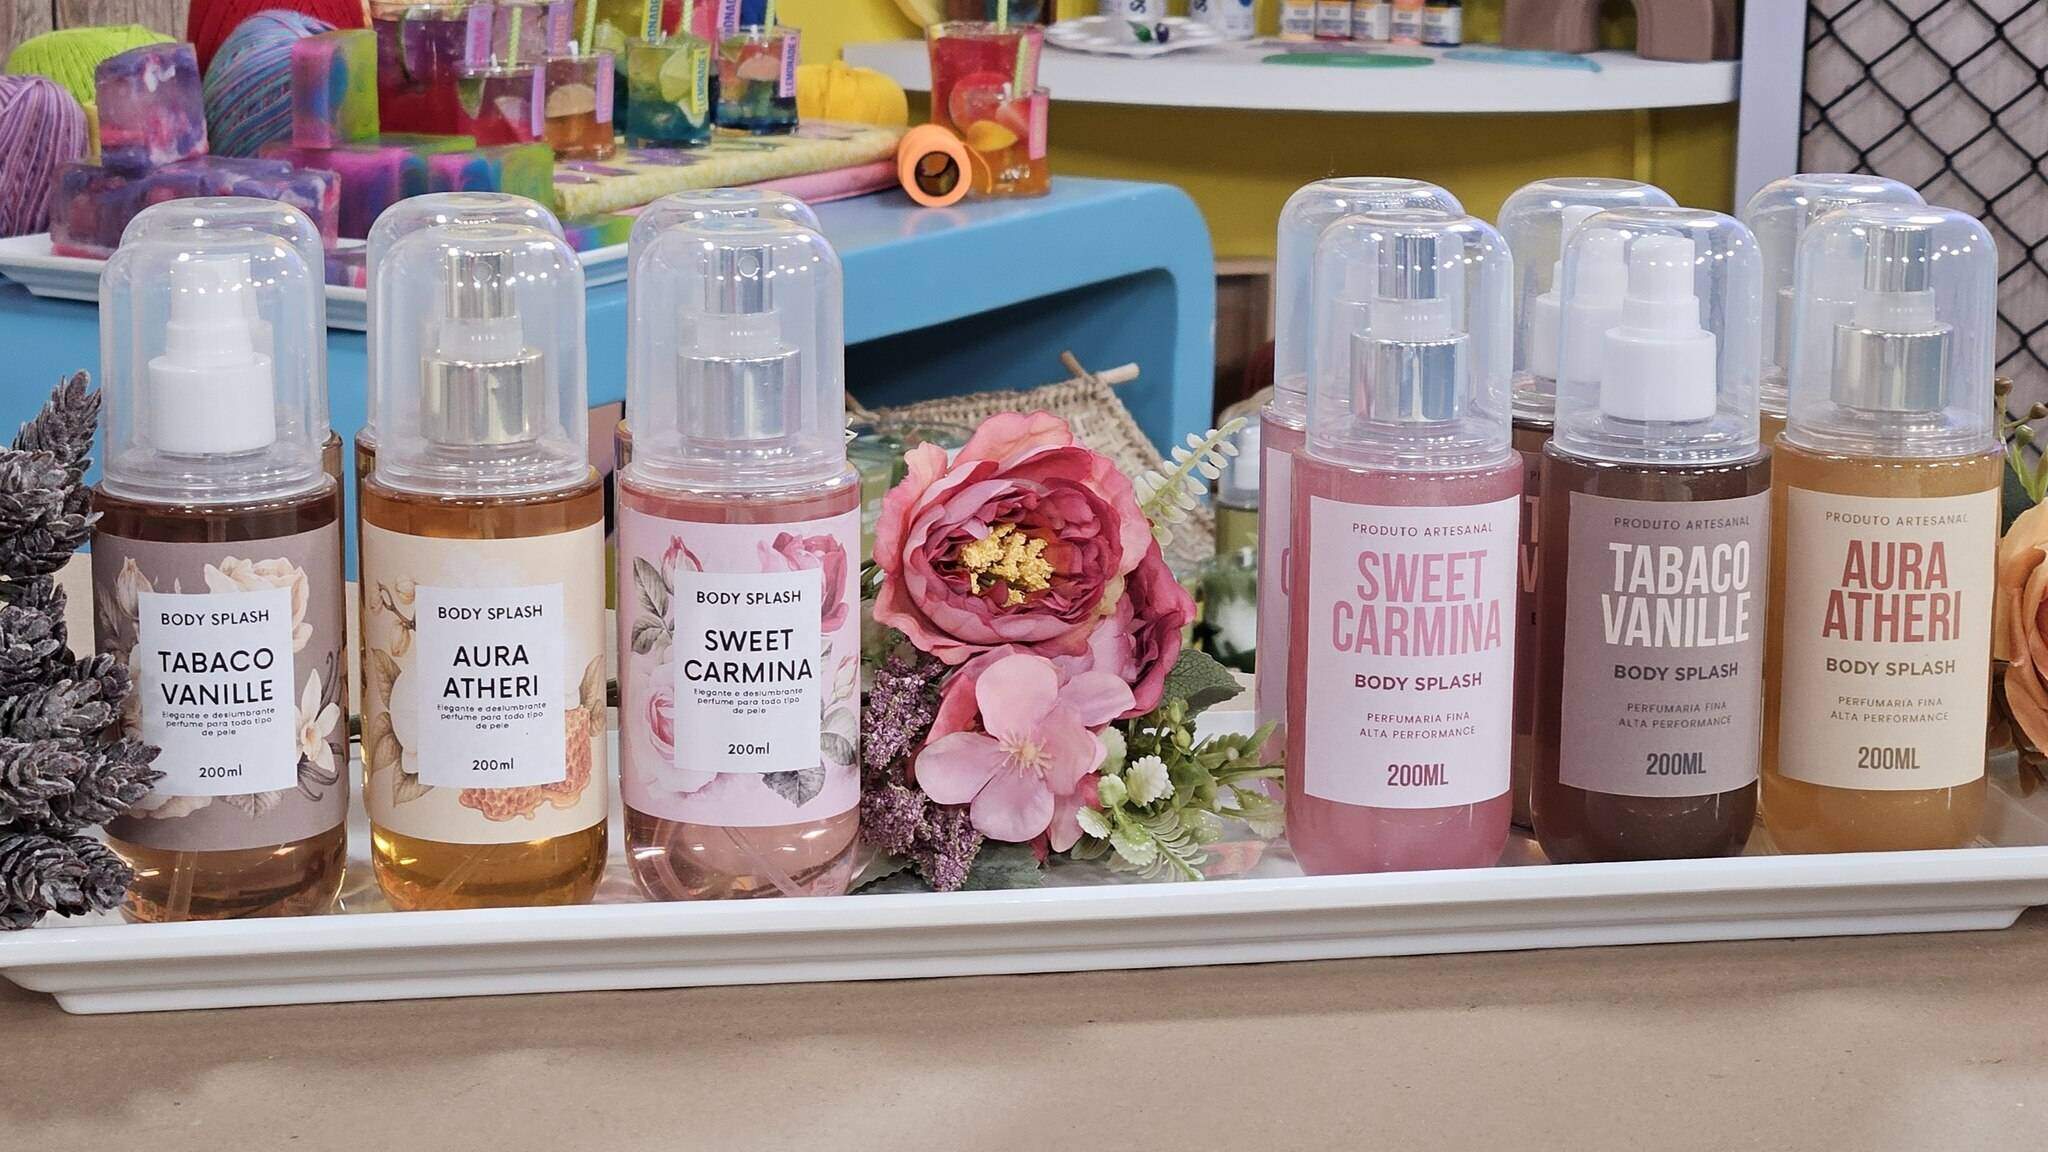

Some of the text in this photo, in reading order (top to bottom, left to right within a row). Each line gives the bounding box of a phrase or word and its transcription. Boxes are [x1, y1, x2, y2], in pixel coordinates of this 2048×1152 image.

[1614, 516, 1750, 530] PRODUTO ARTESANAL
[1826, 511, 1968, 526] PRODUTO ARTESANAL
[1352, 523, 1492, 537] PRODUTO ARTESANAL
[1609, 540, 1750, 595] TABACO
[1842, 540, 1948, 590] AURA
[1357, 549, 1487, 603] SWEET
[696, 590, 801, 605] BODY SPLASH
[161, 610, 270, 626] BODY SPLASH
[438, 605, 543, 620] BODY SPLASH
[1602, 591, 1751, 648] VANILLE
[1822, 589, 1962, 642] ATHERI
[1332, 599, 1502, 657] CARMINA
[704, 629, 794, 652] SWEET
[158, 648, 274, 673] TABACO
[453, 645, 529, 667] AURA
[684, 659, 813, 683] CARMINA
[1614, 662, 1738, 682] BODY SPLASH
[1826, 657, 1956, 676] BODY SPLASH
[443, 675, 538, 699] ATHERI
[1355, 671, 1482, 692] BODY SPLASH
[161, 680, 273, 705] VANILLE
[743, 688, 803, 697] deslumbrante
[486, 702, 546, 712] deslumbrante
[697, 698, 734, 706] perfume
[784, 697, 800, 705] tipo
[1627, 701, 1727, 714] PERFUMARIA FINA
[1838, 696, 1943, 708] PERFUMARIA FINA
[212, 707, 275, 719] deslumbrante
[441, 713, 477, 721] perfume
[527, 711, 543, 719] tipo
[747, 707, 766, 716] pele
[1367, 711, 1470, 724] PERFUMARIA FINA
[1831, 711, 1950, 723] ALTA PERFORMANCE
[166, 720, 203, 728] perfume
[255, 716, 272, 724] tipo
[490, 722, 509, 730] pele
[1619, 715, 1733, 729] ALTA PERFORMANCE
[217, 729, 236, 737] pele
[1359, 725, 1476, 739] ALTA PERFORMANCE
[728, 742, 770, 755] 200ml
[472, 758, 514, 771] 200ml
[1646, 752, 1706, 776] 200ML
[1858, 746, 1920, 770] 200ML
[199, 763, 242, 778] 200ml
[1387, 763, 1448, 787] 200ML
